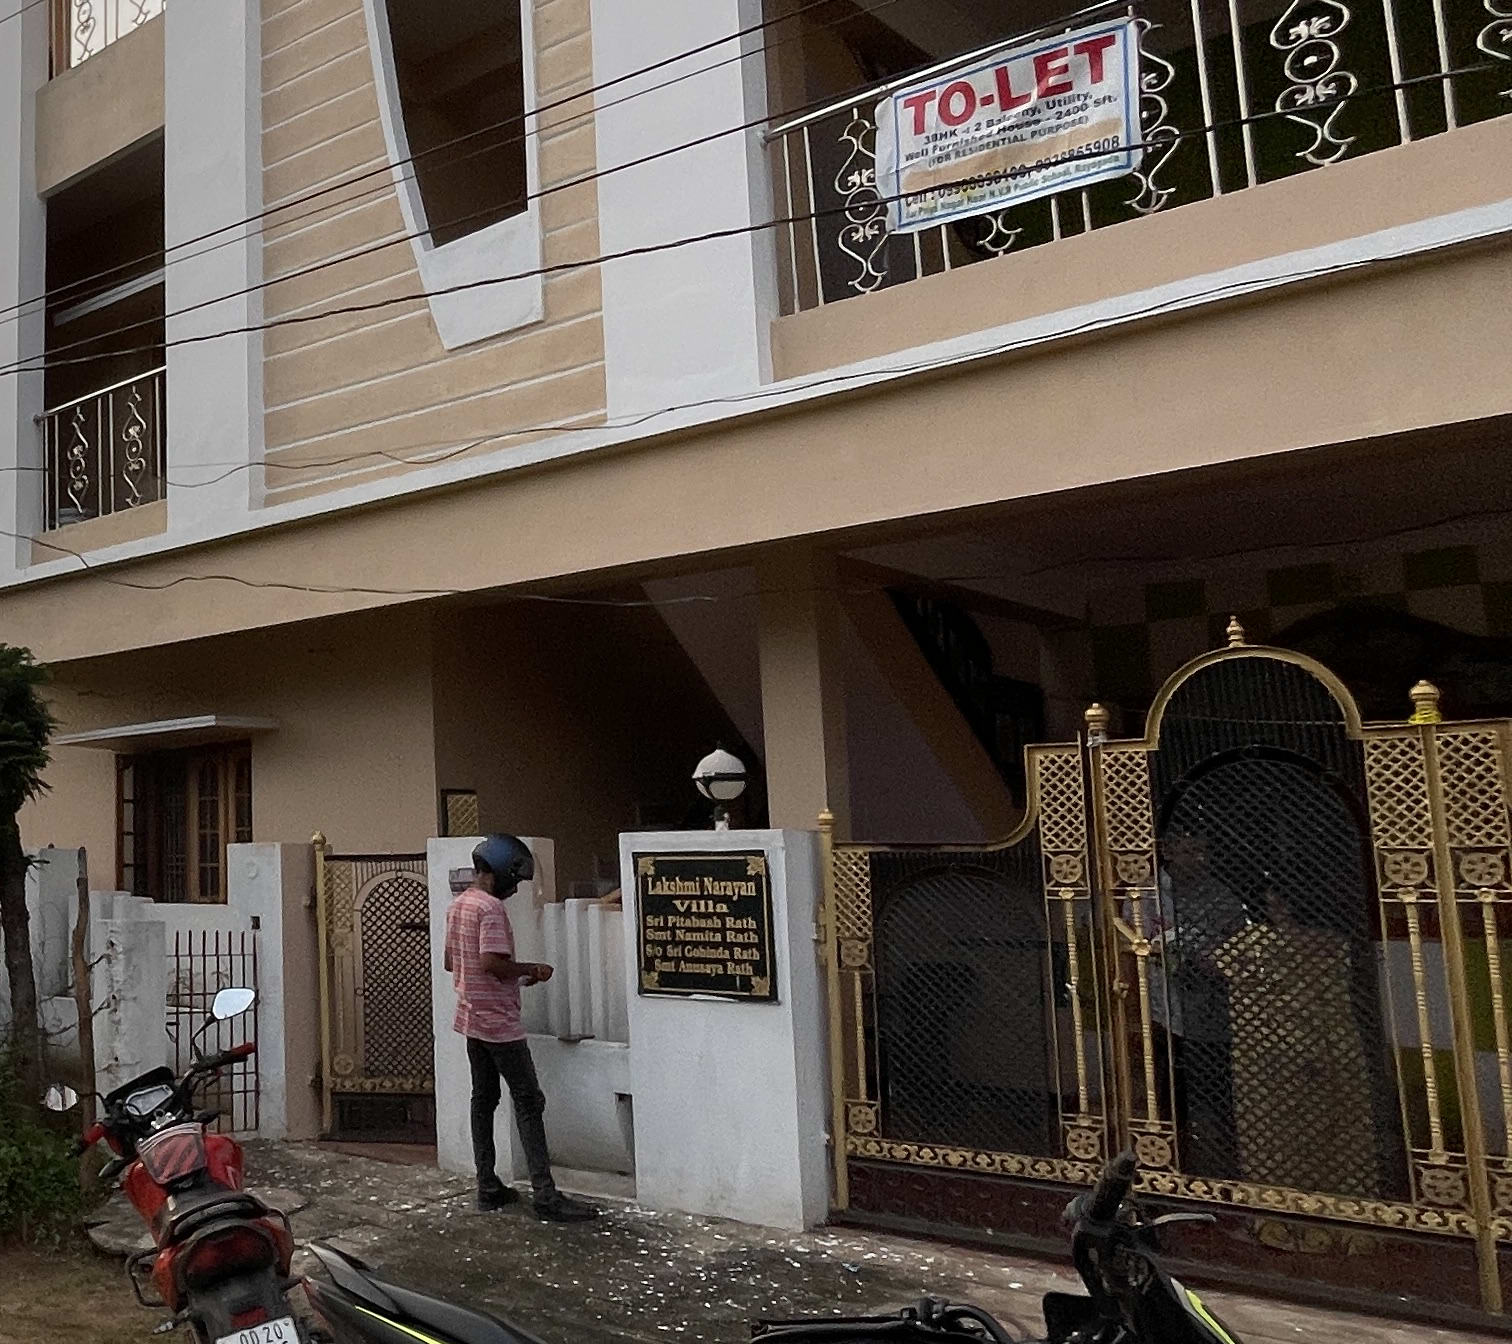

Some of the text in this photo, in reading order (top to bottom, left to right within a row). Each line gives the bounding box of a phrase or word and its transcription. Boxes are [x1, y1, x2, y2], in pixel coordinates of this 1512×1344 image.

[903, 34, 1116, 136] TO-LET
[954, 133, 1028, 159] RESIDENTIAL
[647, 876, 757, 901] Lakshmi Narayan
[671, 899, 729, 913] Villa
[646, 915, 757, 929] Sri Pitabash Rath
[645, 928, 759, 943] Smt Namita Rath
[666, 944, 682, 958] Sri
[733, 946, 760, 961] Rath
[727, 960, 753, 976] Rath
[262, 1322, 283, 1343] 20
